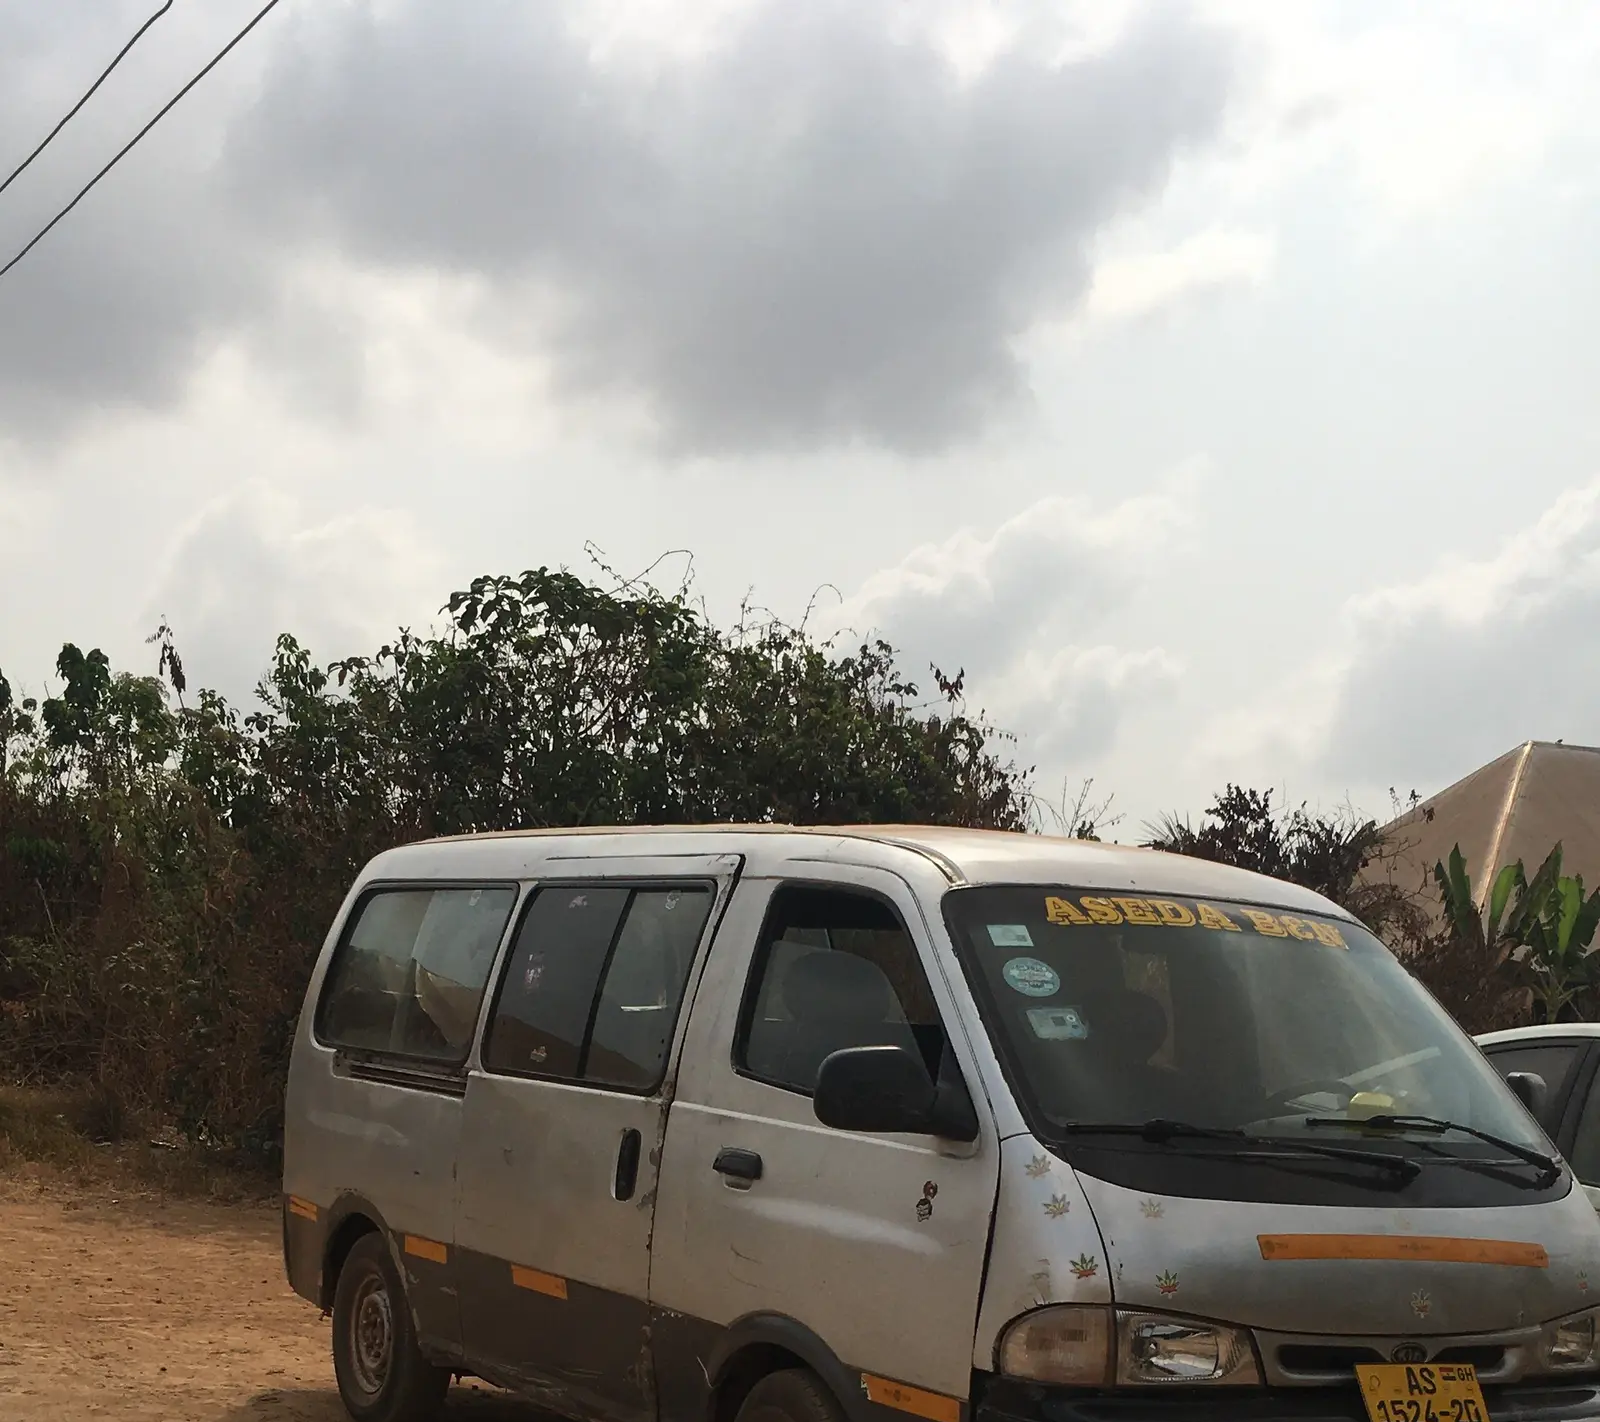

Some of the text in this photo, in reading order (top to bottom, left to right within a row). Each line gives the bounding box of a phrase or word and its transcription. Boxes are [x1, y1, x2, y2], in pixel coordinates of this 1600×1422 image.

[1044, 895, 1243, 932] ASEDA
[1405, 1366, 1474, 1396] AS GH
